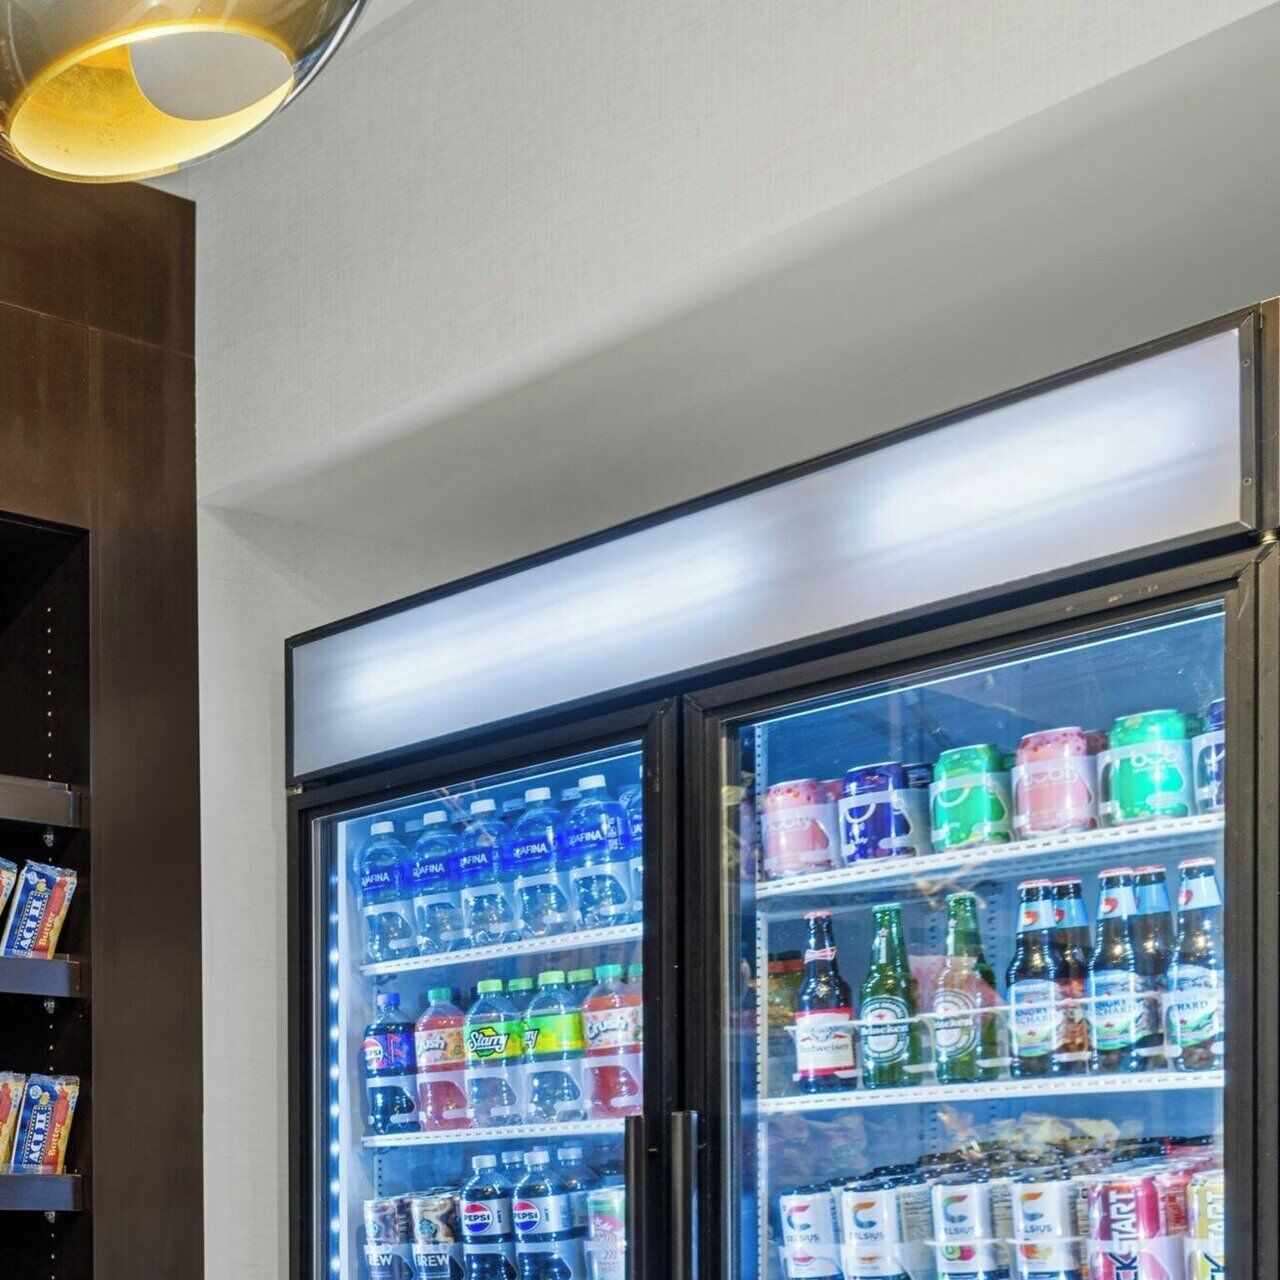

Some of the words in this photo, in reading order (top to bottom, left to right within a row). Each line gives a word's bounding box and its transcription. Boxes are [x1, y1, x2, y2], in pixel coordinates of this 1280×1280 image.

[19, 916, 39, 950] ACT
[38, 911, 56, 946] Butter
[586, 1018, 627, 1039] Crush
[468, 1032, 510, 1054] Starry
[28, 1130, 44, 1162] ACT
[48, 1122, 62, 1156] Butter
[463, 1213, 491, 1222] PEPSI
[513, 1211, 539, 1221] PEPSI
[415, 1253, 450, 1267] BREW
